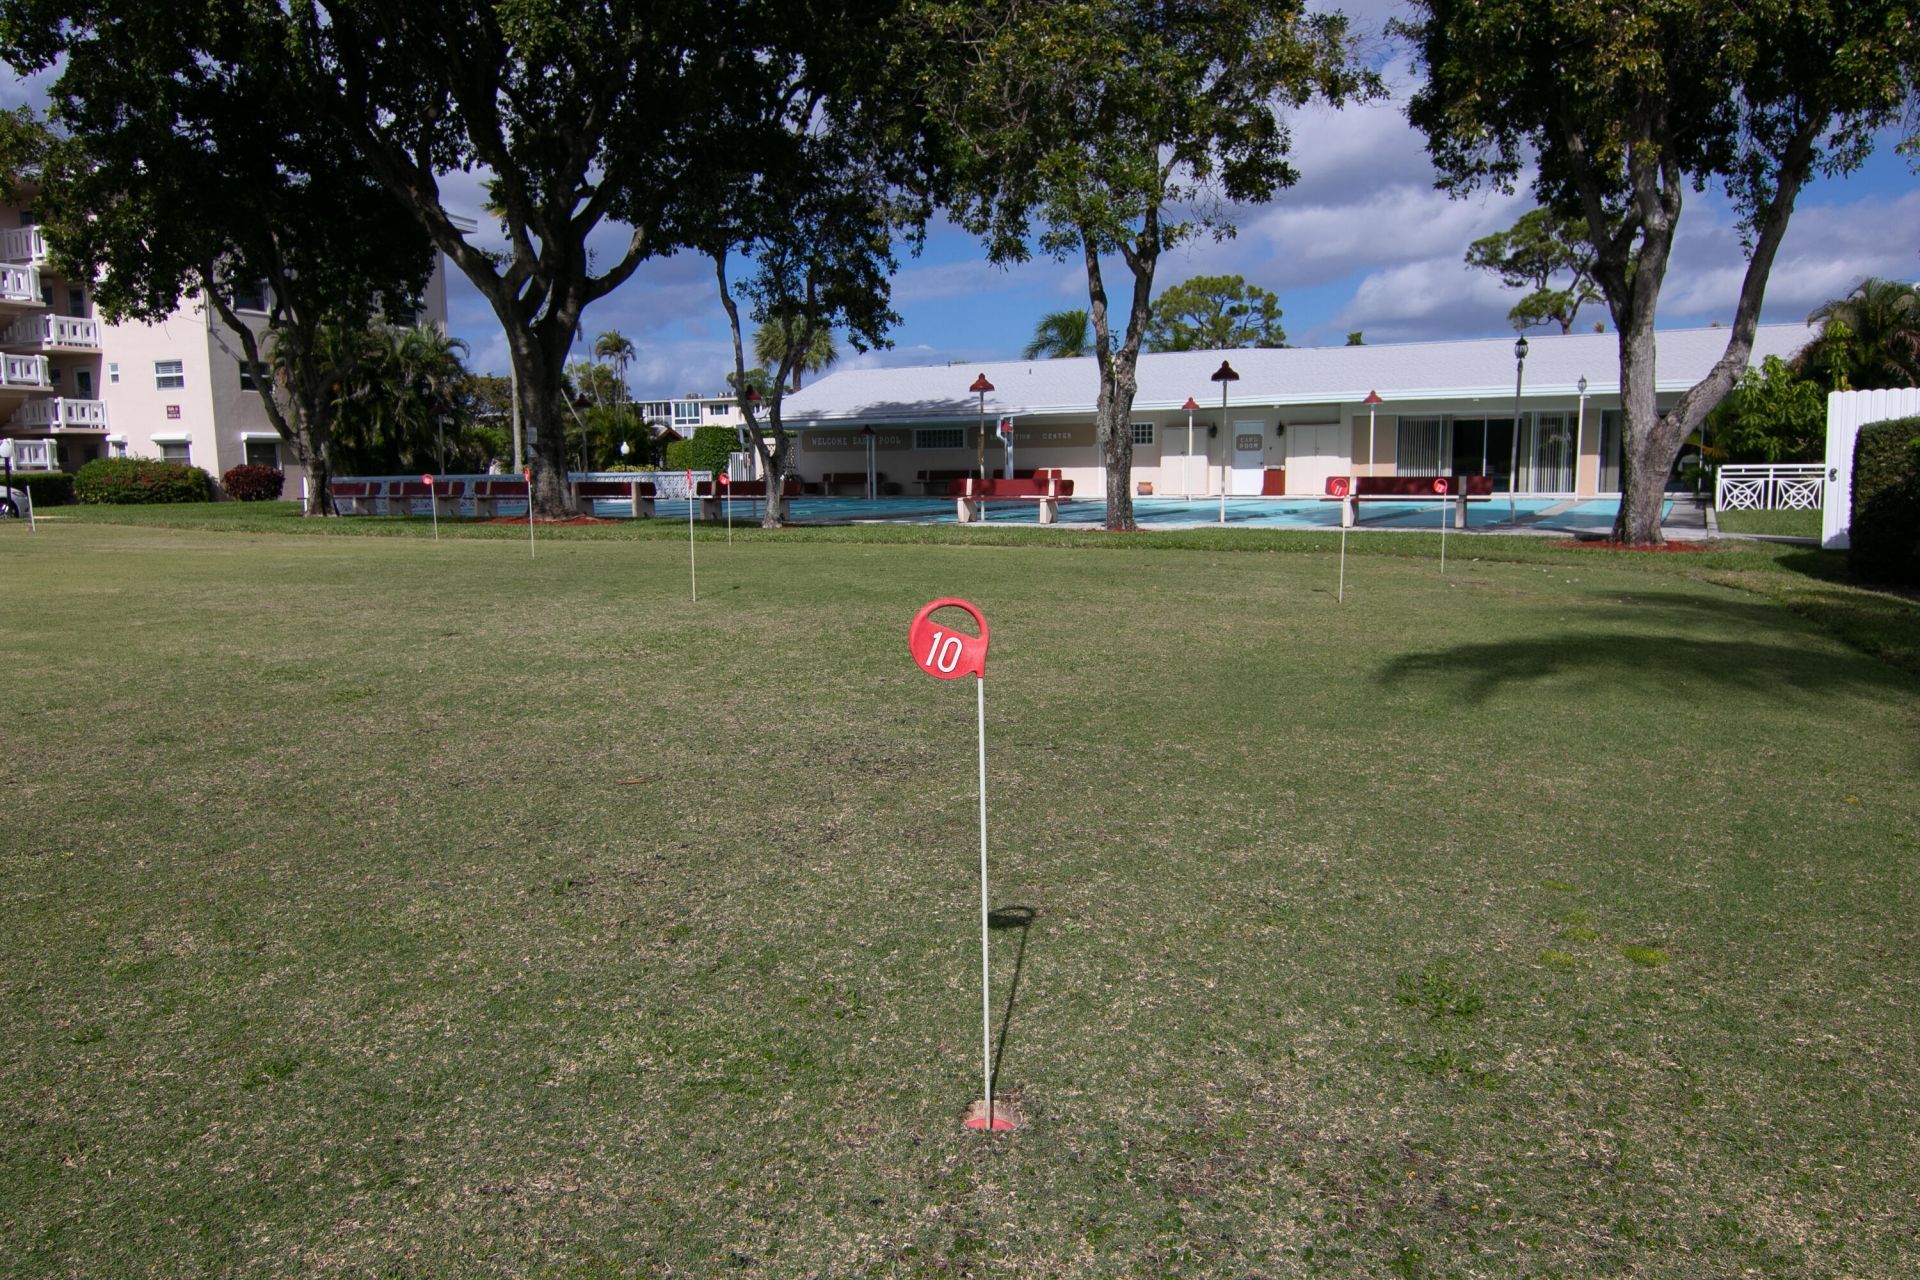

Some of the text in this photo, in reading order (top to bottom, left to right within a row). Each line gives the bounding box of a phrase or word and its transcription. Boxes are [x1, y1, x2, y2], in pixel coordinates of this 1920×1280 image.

[811, 437, 848, 446] WELCOME
[879, 435, 901, 446] POOL
[925, 631, 963, 673] 10
